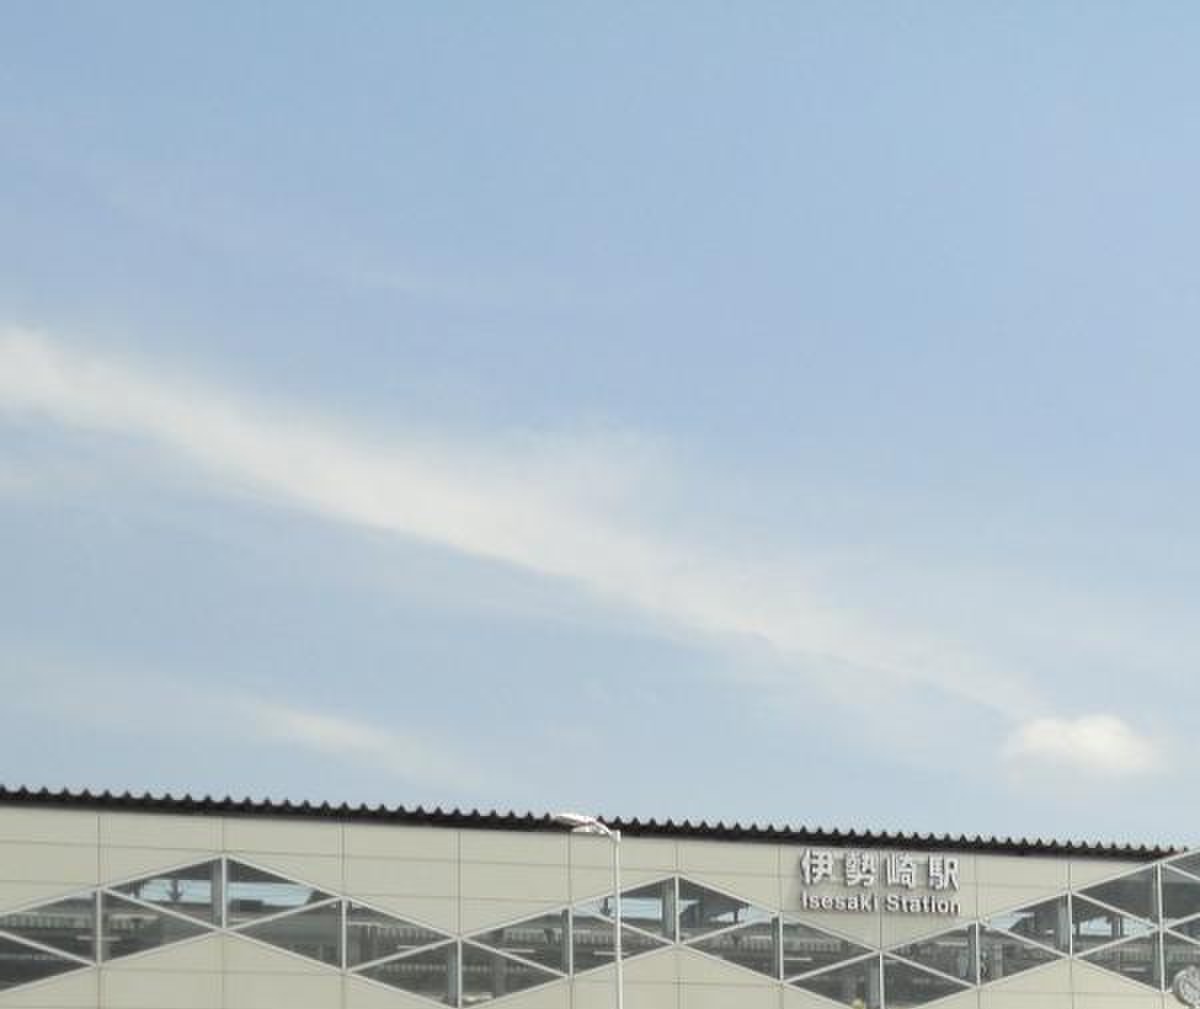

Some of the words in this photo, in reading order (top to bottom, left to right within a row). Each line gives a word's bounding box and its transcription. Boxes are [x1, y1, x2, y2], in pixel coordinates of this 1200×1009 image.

[801, 850, 960, 890] 伊勢崎駅
[802, 892, 878, 910] Isesaki
[886, 895, 960, 914] Station
